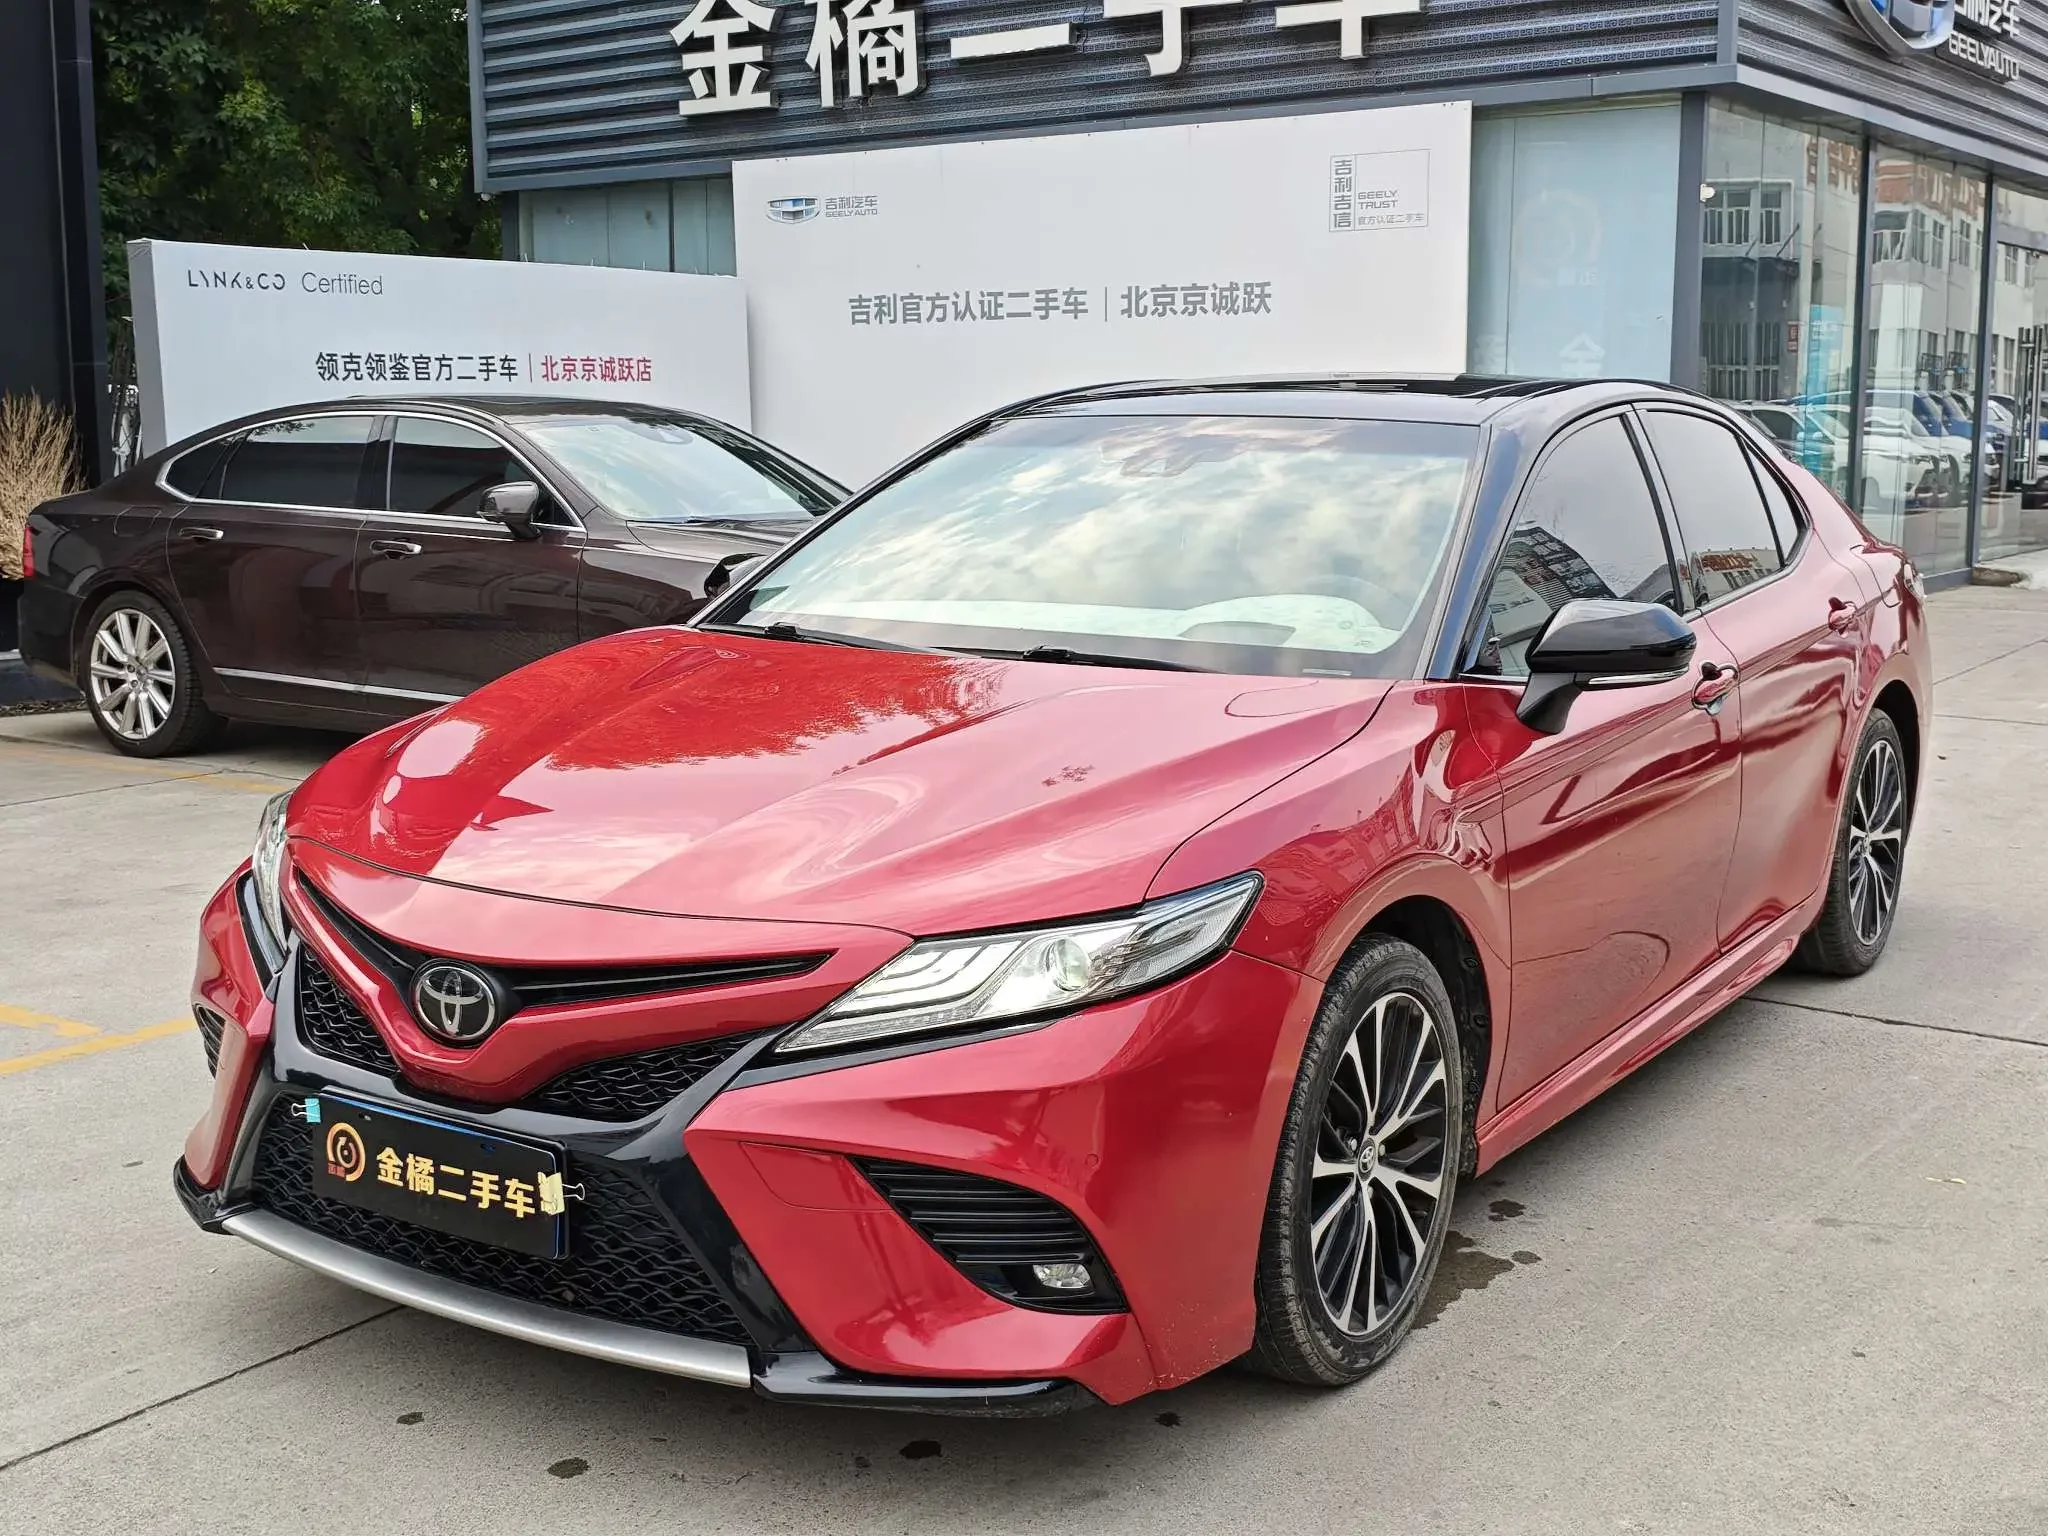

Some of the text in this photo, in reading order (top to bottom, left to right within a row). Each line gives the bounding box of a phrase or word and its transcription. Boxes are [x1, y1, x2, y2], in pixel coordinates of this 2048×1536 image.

[825, 195, 878, 210] 吉利汽车
[1333, 159, 1352, 228] 吉利吉信
[1358, 190, 1398, 200] GEELY
[1358, 199, 1398, 210] TRUST
[301, 271, 383, 296] Certified
[848, 280, 1272, 325] 吉利官方认证二手车 北京京诚跃
[315, 350, 653, 383] 领克领鉴官方二手车 北京京诚跃店
[376, 1146, 537, 1218] 金橘二手车
